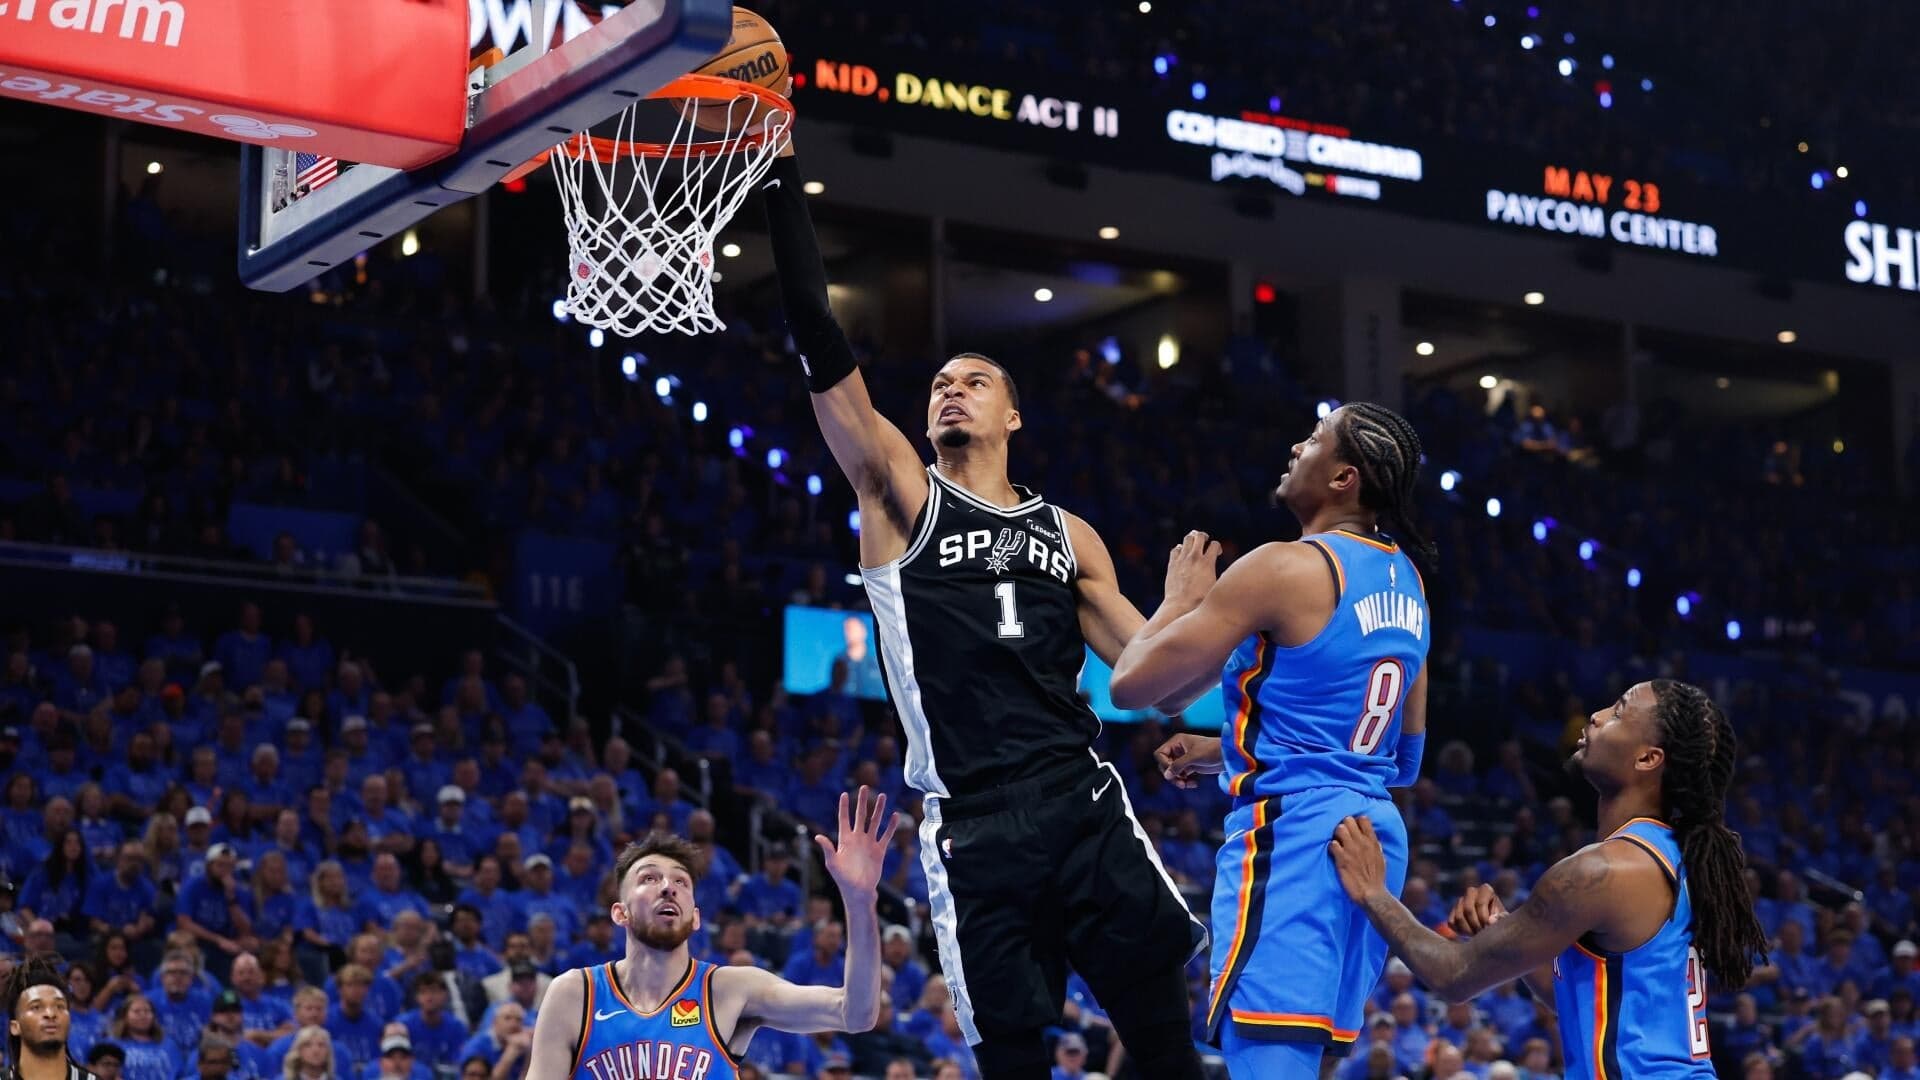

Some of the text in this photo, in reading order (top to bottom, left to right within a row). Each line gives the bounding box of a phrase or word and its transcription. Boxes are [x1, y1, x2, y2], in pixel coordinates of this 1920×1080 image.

[1, 75, 205, 123] State
[815, 58, 890, 103] KID,
[895, 72, 1012, 120] DANCE
[1017, 94, 1082, 131] ACT
[1544, 165, 1660, 213] MAY 23
[1486, 189, 1718, 256] PAYCOM CENTER
[994, 581, 1025, 639] 1
[1354, 591, 1423, 641] WILLIAMS
[1349, 656, 1406, 756] 8
